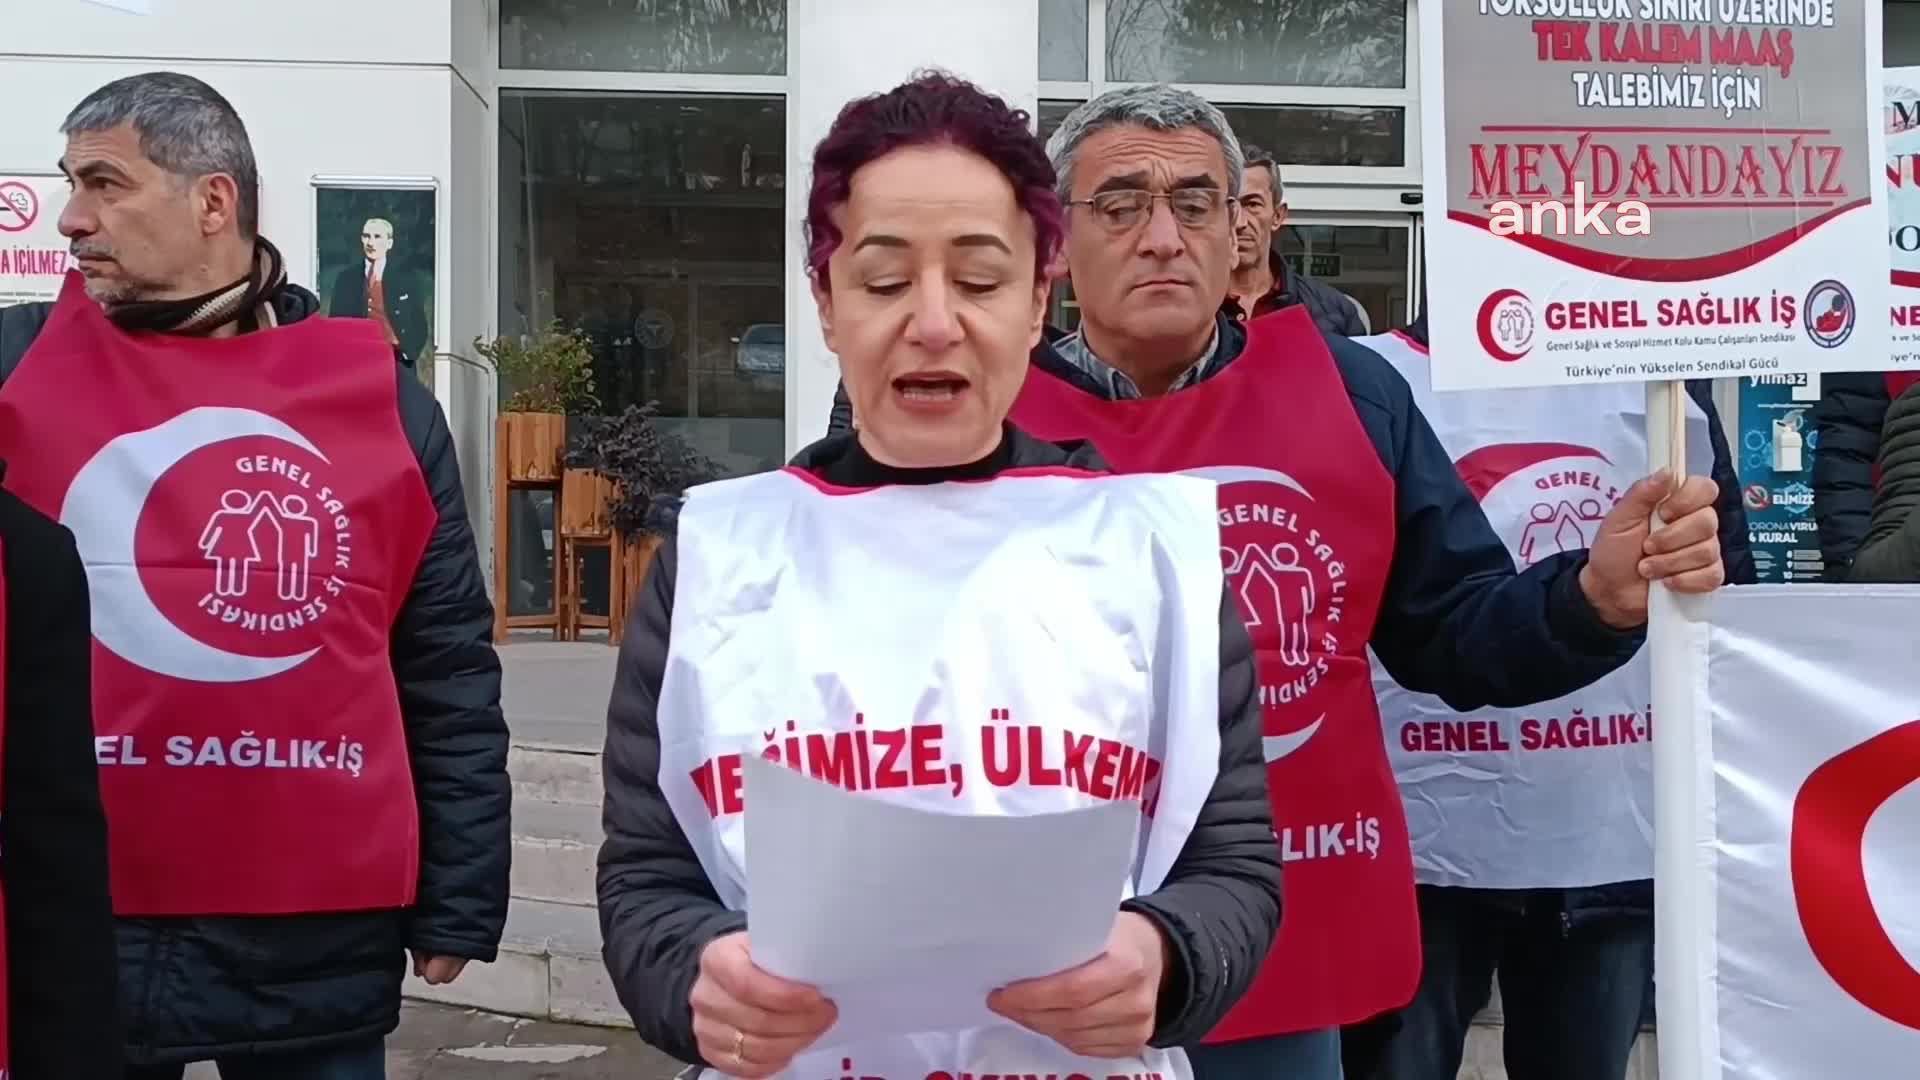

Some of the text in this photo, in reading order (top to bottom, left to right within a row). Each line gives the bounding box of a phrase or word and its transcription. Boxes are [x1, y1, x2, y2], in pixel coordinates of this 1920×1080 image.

[1532, 20, 1795, 80] TEK KALEM MAAŞ
[1572, 65, 1761, 119] TALEBİMİZ İÇİN
[1468, 132, 1848, 199] MEYDANDAYIZ
[13, 245, 67, 278] İÇİLMEZ
[1545, 301, 1647, 330] GENEL
[1656, 291, 1761, 327] SAĞLIK
[1771, 289, 1796, 329] İŞ
[1546, 340, 1573, 351] Genel
[1643, 336, 1672, 347] Hizmet
[1565, 357, 1779, 378] Türkiye'nin Yükselen Sendikal Gücü
[236, 455, 312, 489] GENEL
[316, 486, 351, 569] SAĞLIK
[1758, 532, 1798, 543] KURAL
[1216, 504, 1299, 533] GENEL
[1305, 528, 1347, 623] SAĞLIK
[198, 592, 328, 636] SENDİKASI
[165, 730, 364, 777] SAĞLIK-İŞ
[1400, 721, 1510, 752] GENEL
[1274, 811, 1381, 861] LIK-İŞ
